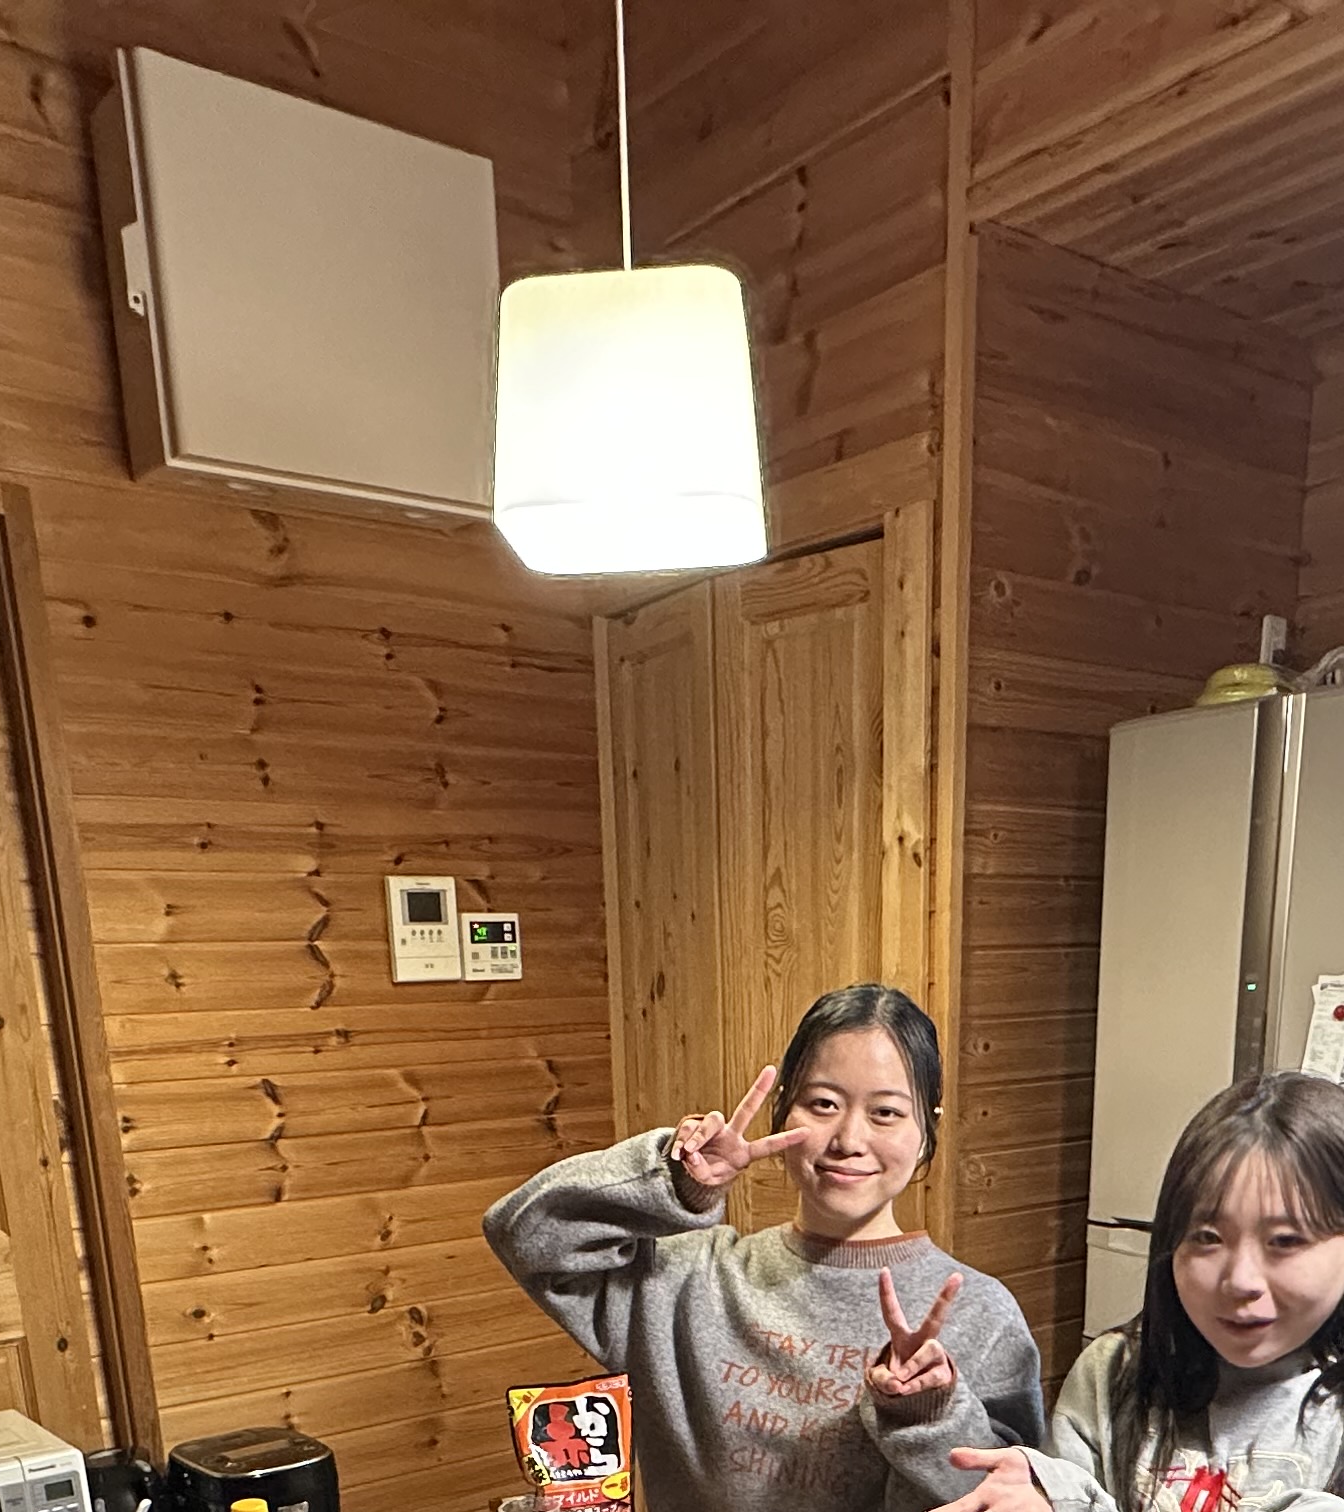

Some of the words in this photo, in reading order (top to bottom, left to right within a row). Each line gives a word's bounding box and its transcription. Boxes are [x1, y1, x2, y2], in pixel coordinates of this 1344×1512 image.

[825, 1344, 869, 1371] TR
[721, 1360, 760, 1387] TO
[768, 1374, 862, 1410] YOURS
[722, 1400, 788, 1436] AND
